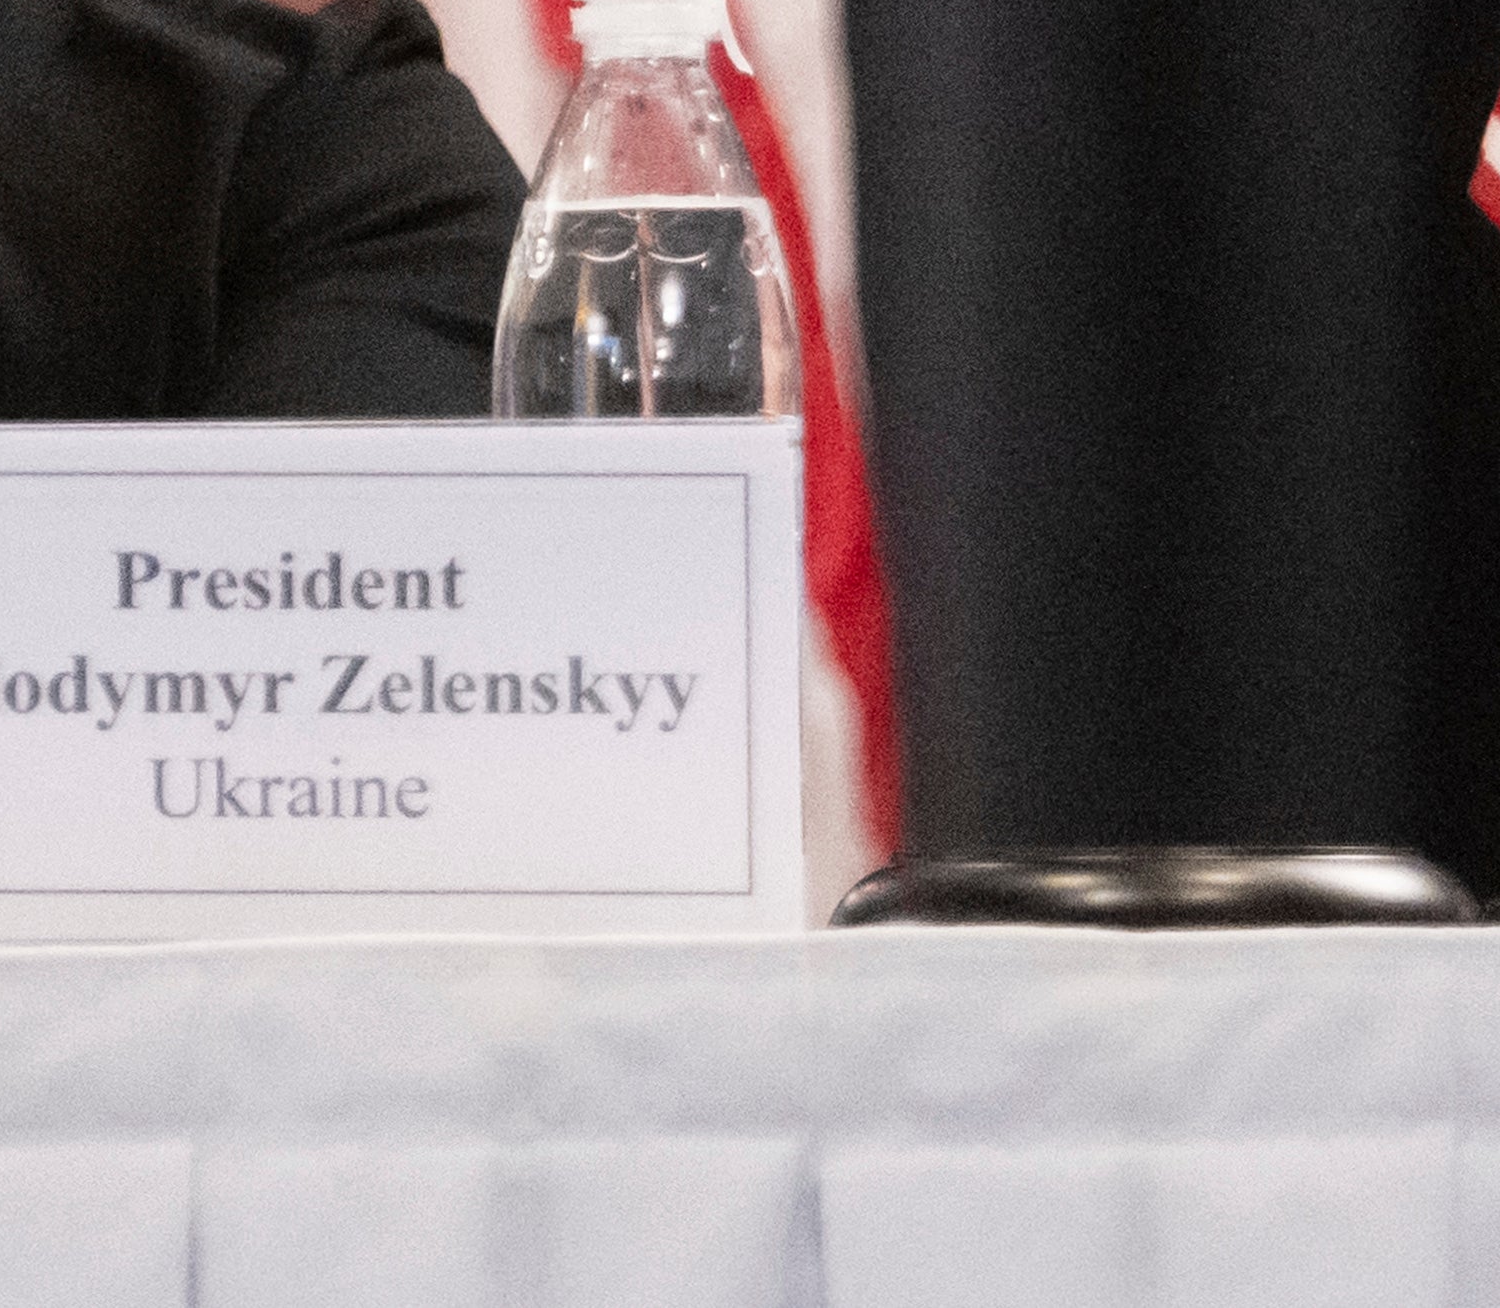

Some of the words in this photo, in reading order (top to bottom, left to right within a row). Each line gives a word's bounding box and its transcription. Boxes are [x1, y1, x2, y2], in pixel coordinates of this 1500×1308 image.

[113, 550, 466, 612] President
[319, 652, 699, 731] Zelenskyy
[151, 756, 431, 820] Ukraine
